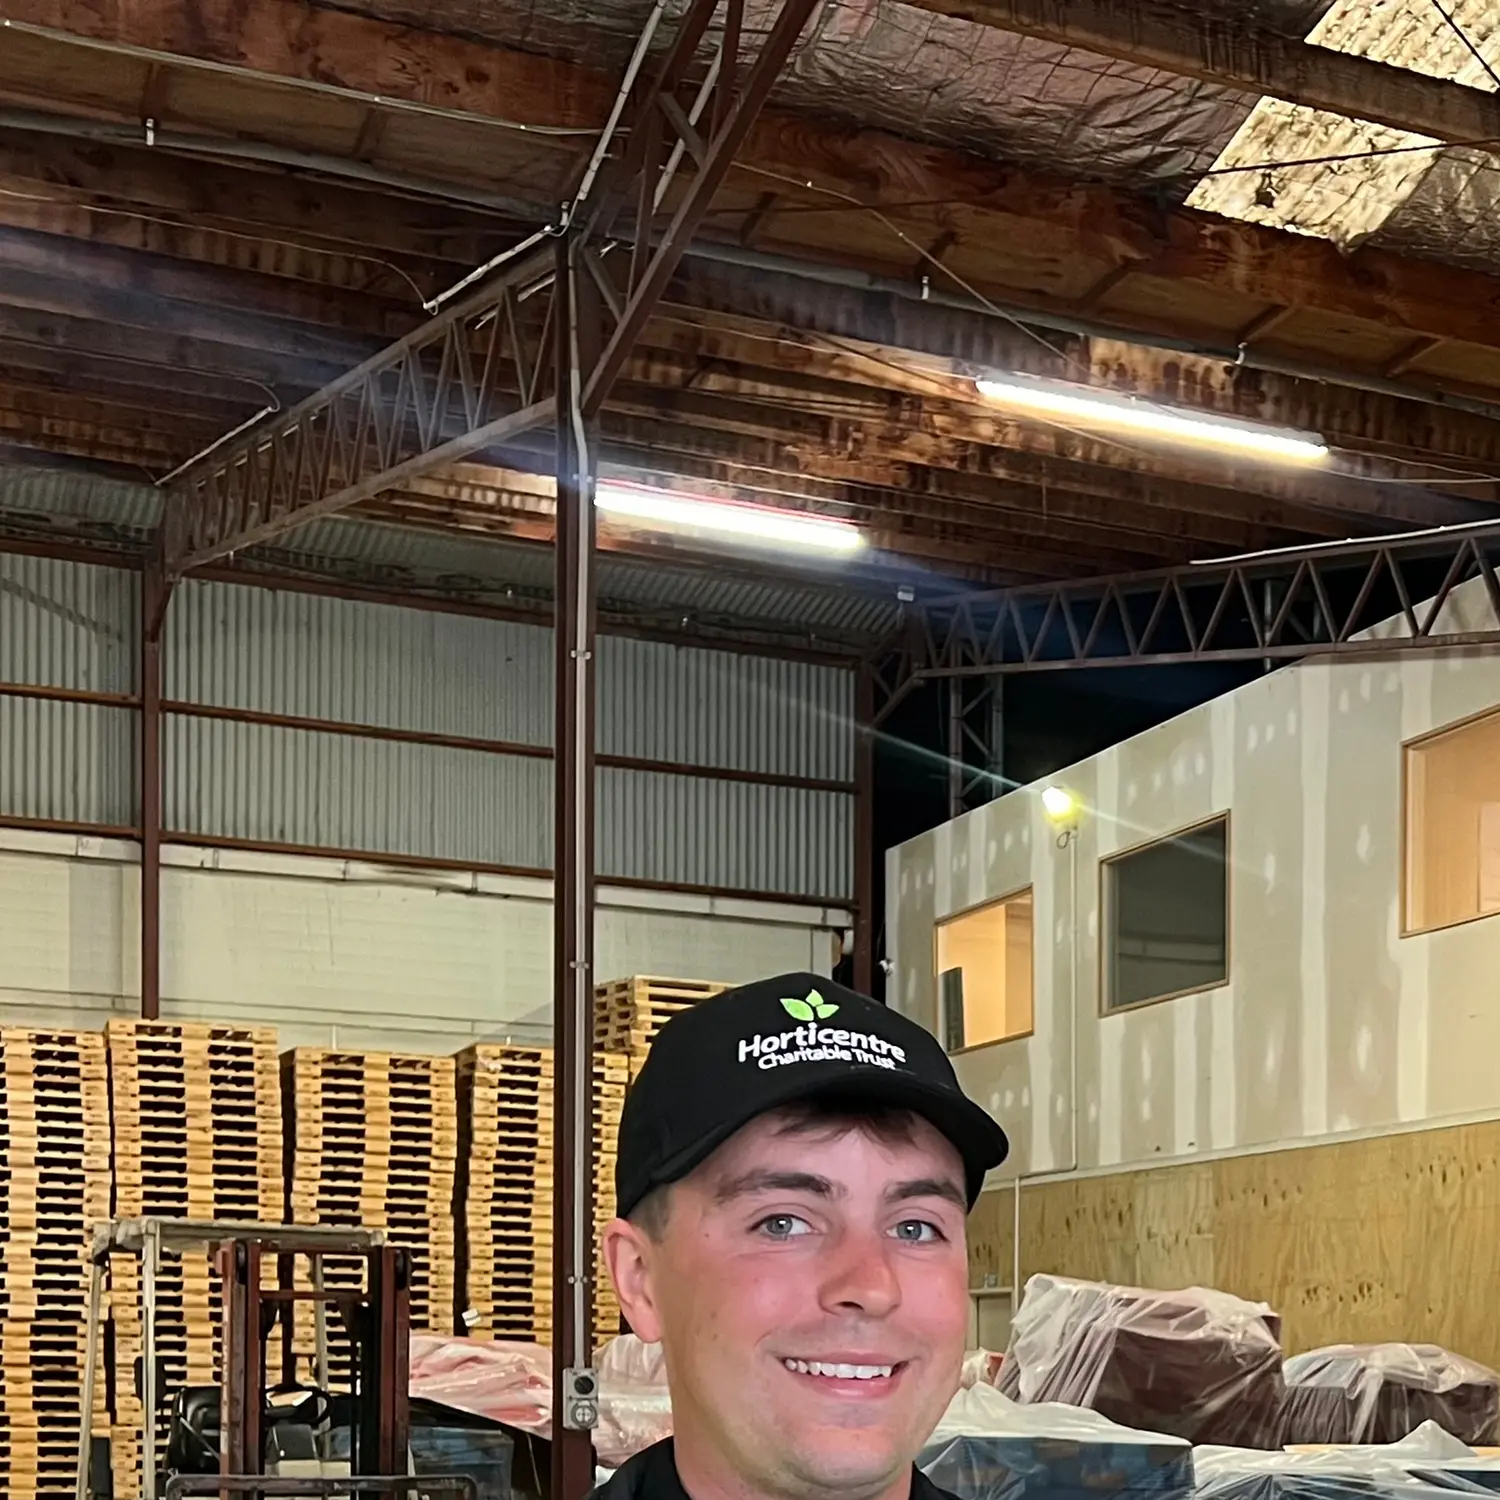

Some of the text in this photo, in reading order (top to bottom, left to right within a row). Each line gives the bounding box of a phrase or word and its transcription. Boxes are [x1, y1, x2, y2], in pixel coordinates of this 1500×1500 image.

[738, 1022, 906, 1063] Horticentre
[758, 1045, 896, 1070] Charitable Trust
